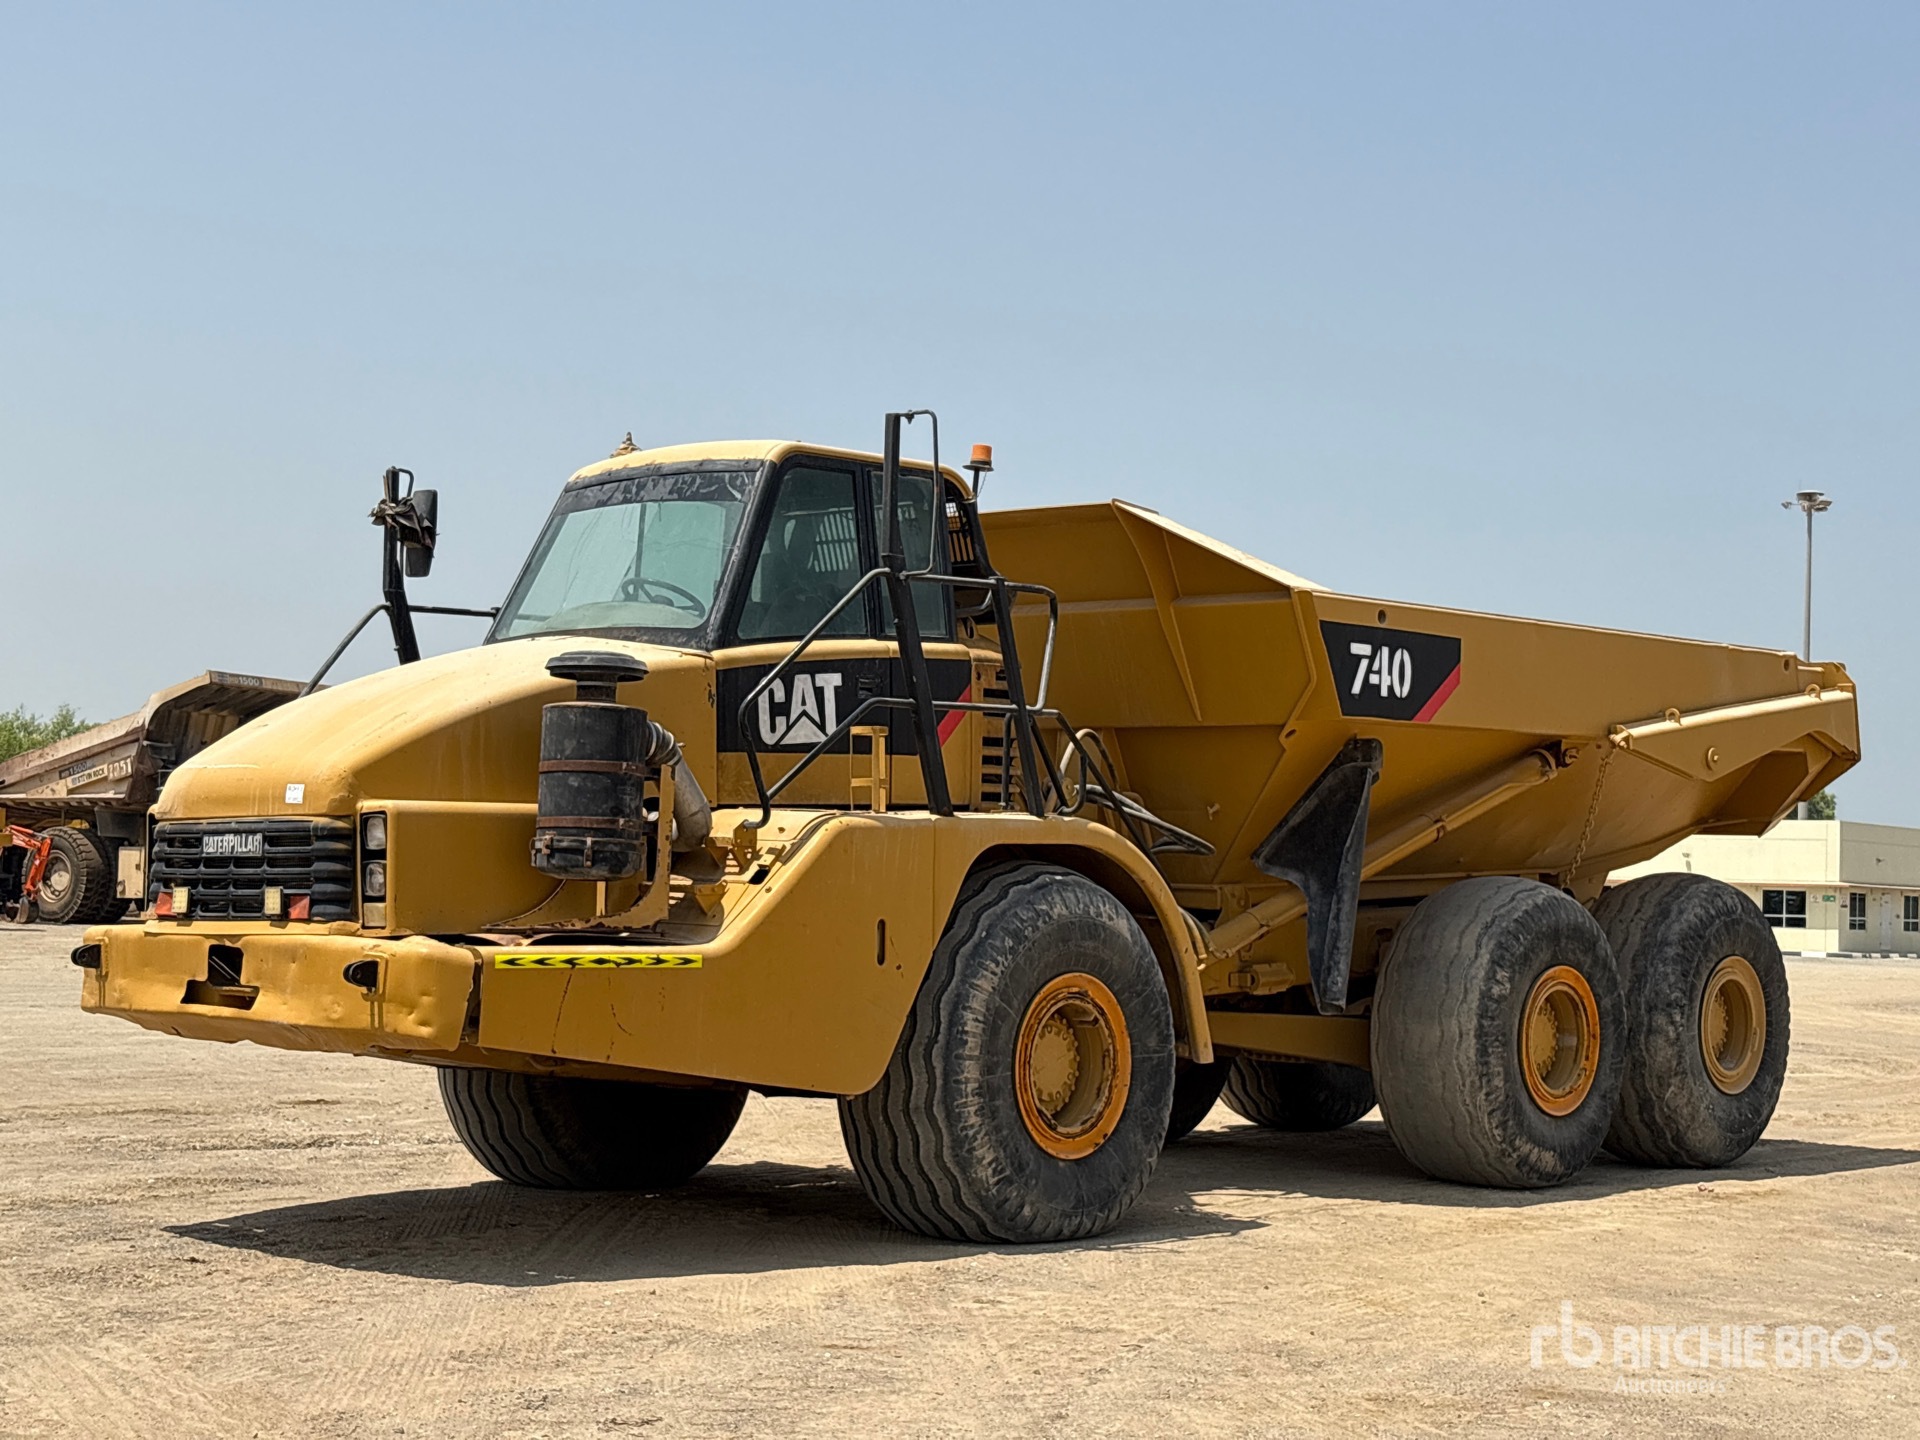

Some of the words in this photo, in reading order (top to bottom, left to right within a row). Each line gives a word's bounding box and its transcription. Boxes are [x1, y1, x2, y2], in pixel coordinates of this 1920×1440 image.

[1350, 642, 1412, 698] 740
[758, 673, 842, 745] CAT
[203, 834, 261, 854] CATERPILLAR
